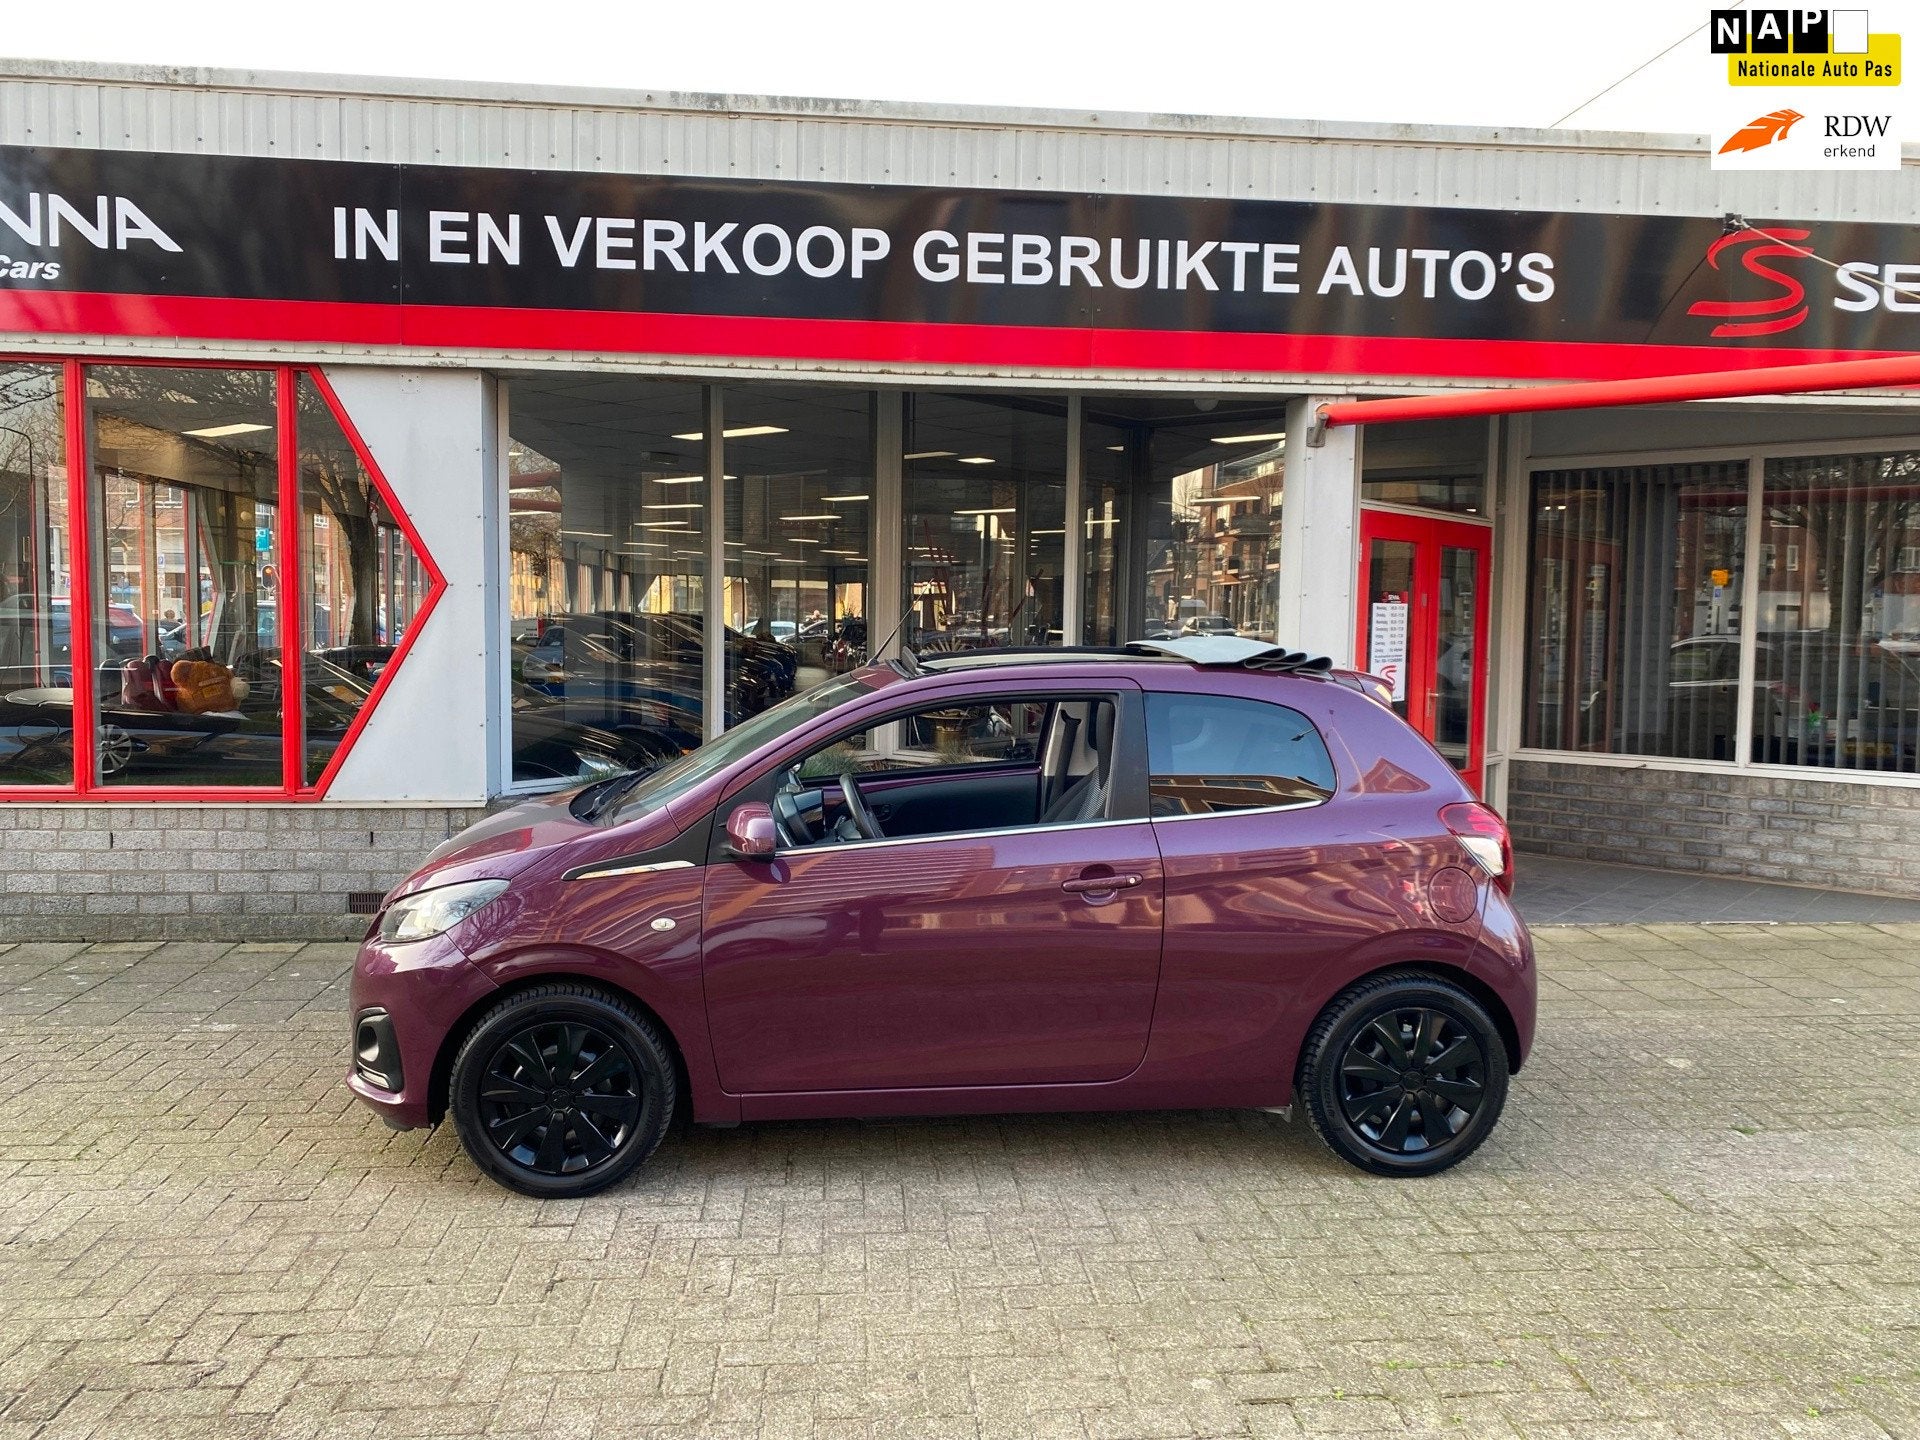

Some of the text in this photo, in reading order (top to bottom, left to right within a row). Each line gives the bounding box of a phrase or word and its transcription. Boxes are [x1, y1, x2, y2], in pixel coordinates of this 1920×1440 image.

[333, 206, 1555, 303] IN EN VERKOOP GEBRUIKTE AUTO'S
[1833, 261, 1920, 313] SE
